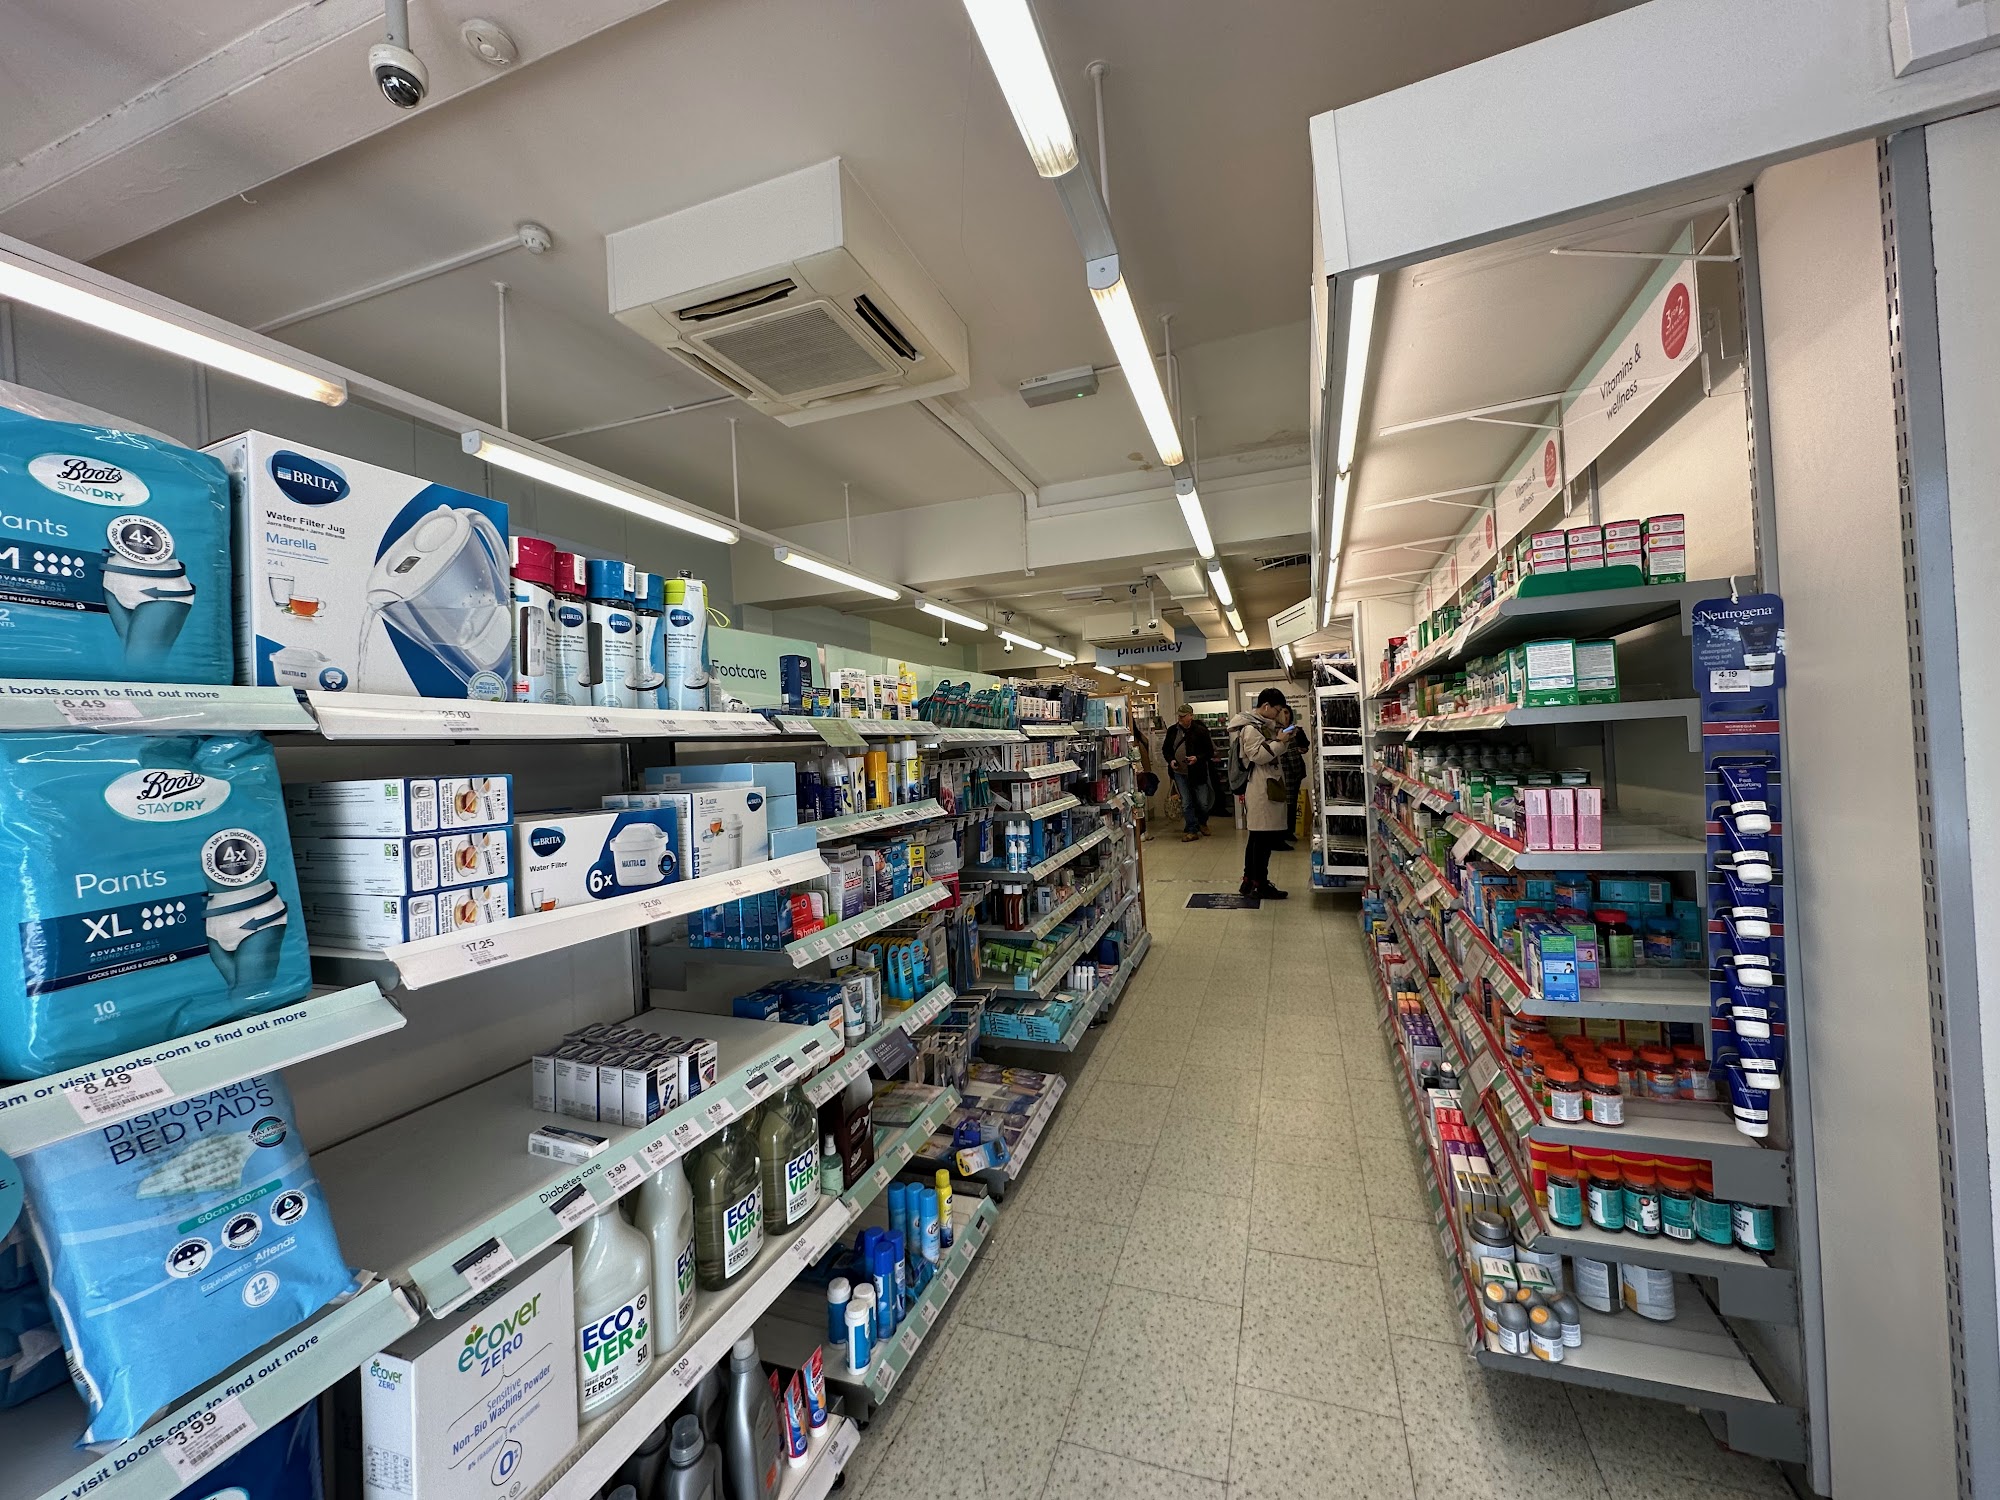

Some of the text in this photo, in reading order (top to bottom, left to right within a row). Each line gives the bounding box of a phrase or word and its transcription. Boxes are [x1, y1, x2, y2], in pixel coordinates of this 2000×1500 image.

[1666, 296, 1683, 328] 3 2
[1600, 343, 1641, 400] Vitamins &
[1607, 380, 1637, 420] wellness
[57, 458, 123, 483] Boots
[292, 470, 340, 493] BRITA
[0, 510, 69, 537] ants
[266, 510, 345, 534] Water Filter Jug
[129, 530, 154, 546] 4x
[266, 532, 317, 551] Marella
[567, 613, 583, 621] BRITA
[615, 619, 632, 628] BRITA
[676, 615, 692, 623] BRITA
[1700, 607, 1773, 622] Neutrogena
[1117, 639, 1184, 657] pharmacy
[711, 660, 767, 680] Footcare
[9, 685, 220, 699] boots.com to find out more
[136, 771, 205, 799] Boots
[137, 798, 206, 815] STAYDRY
[211, 832, 258, 846] DRY DISCREET
[540, 836, 561, 846] BRITA
[223, 846, 247, 862] 4x
[622, 860, 640, 868] MAXTRA
[213, 872, 242, 883] CONTROL
[529, 865, 549, 873] Water
[589, 869, 613, 893] 6x
[75, 868, 168, 899] Pants
[1734, 886, 1765, 894] Absorbing
[82, 913, 133, 943] XL
[90, 942, 142, 958] ADVANCED
[88, 970, 109, 980] LOCKS
[118, 963, 137, 973] LEAKS
[142, 957, 168, 967] ODOURS
[93, 1000, 117, 1016] 10
[0, 1008, 308, 1110] am or visit boots.com to find out more
[746, 1053, 781, 1075] Diabetes care
[659, 1073, 677, 1086] lancets
[103, 1077, 267, 1142] DISPOSABLE
[195, 1088, 274, 1131] PADS
[110, 1119, 186, 1165] BED
[788, 1151, 814, 1180] ECO
[539, 1163, 602, 1204] Diabetes care
[789, 1166, 814, 1195] VER
[197, 1206, 230, 1224] 60cm
[238, 1187, 268, 1206] 60cm
[727, 1193, 756, 1229] ECO
[728, 1212, 756, 1246] VER
[254, 1236, 296, 1263] Attends
[201, 1266, 243, 1293] Equivalent
[251, 1277, 270, 1296] 12
[458, 1293, 541, 1373] ecover
[583, 1305, 634, 1352] ECO
[481, 1332, 523, 1377] ZERO
[583, 1327, 634, 1373] VER
[637, 1343, 647, 1363] 50
[370, 1365, 402, 1384] ecover
[378, 1380, 396, 1391] ZERO
[585, 1374, 619, 1397] ZERO%
[487, 1378, 521, 1412] Sensitive
[72, 1334, 320, 1497] visit boots.com to find out more
[452, 1364, 551, 1455] Non-Bio Washing Powder
